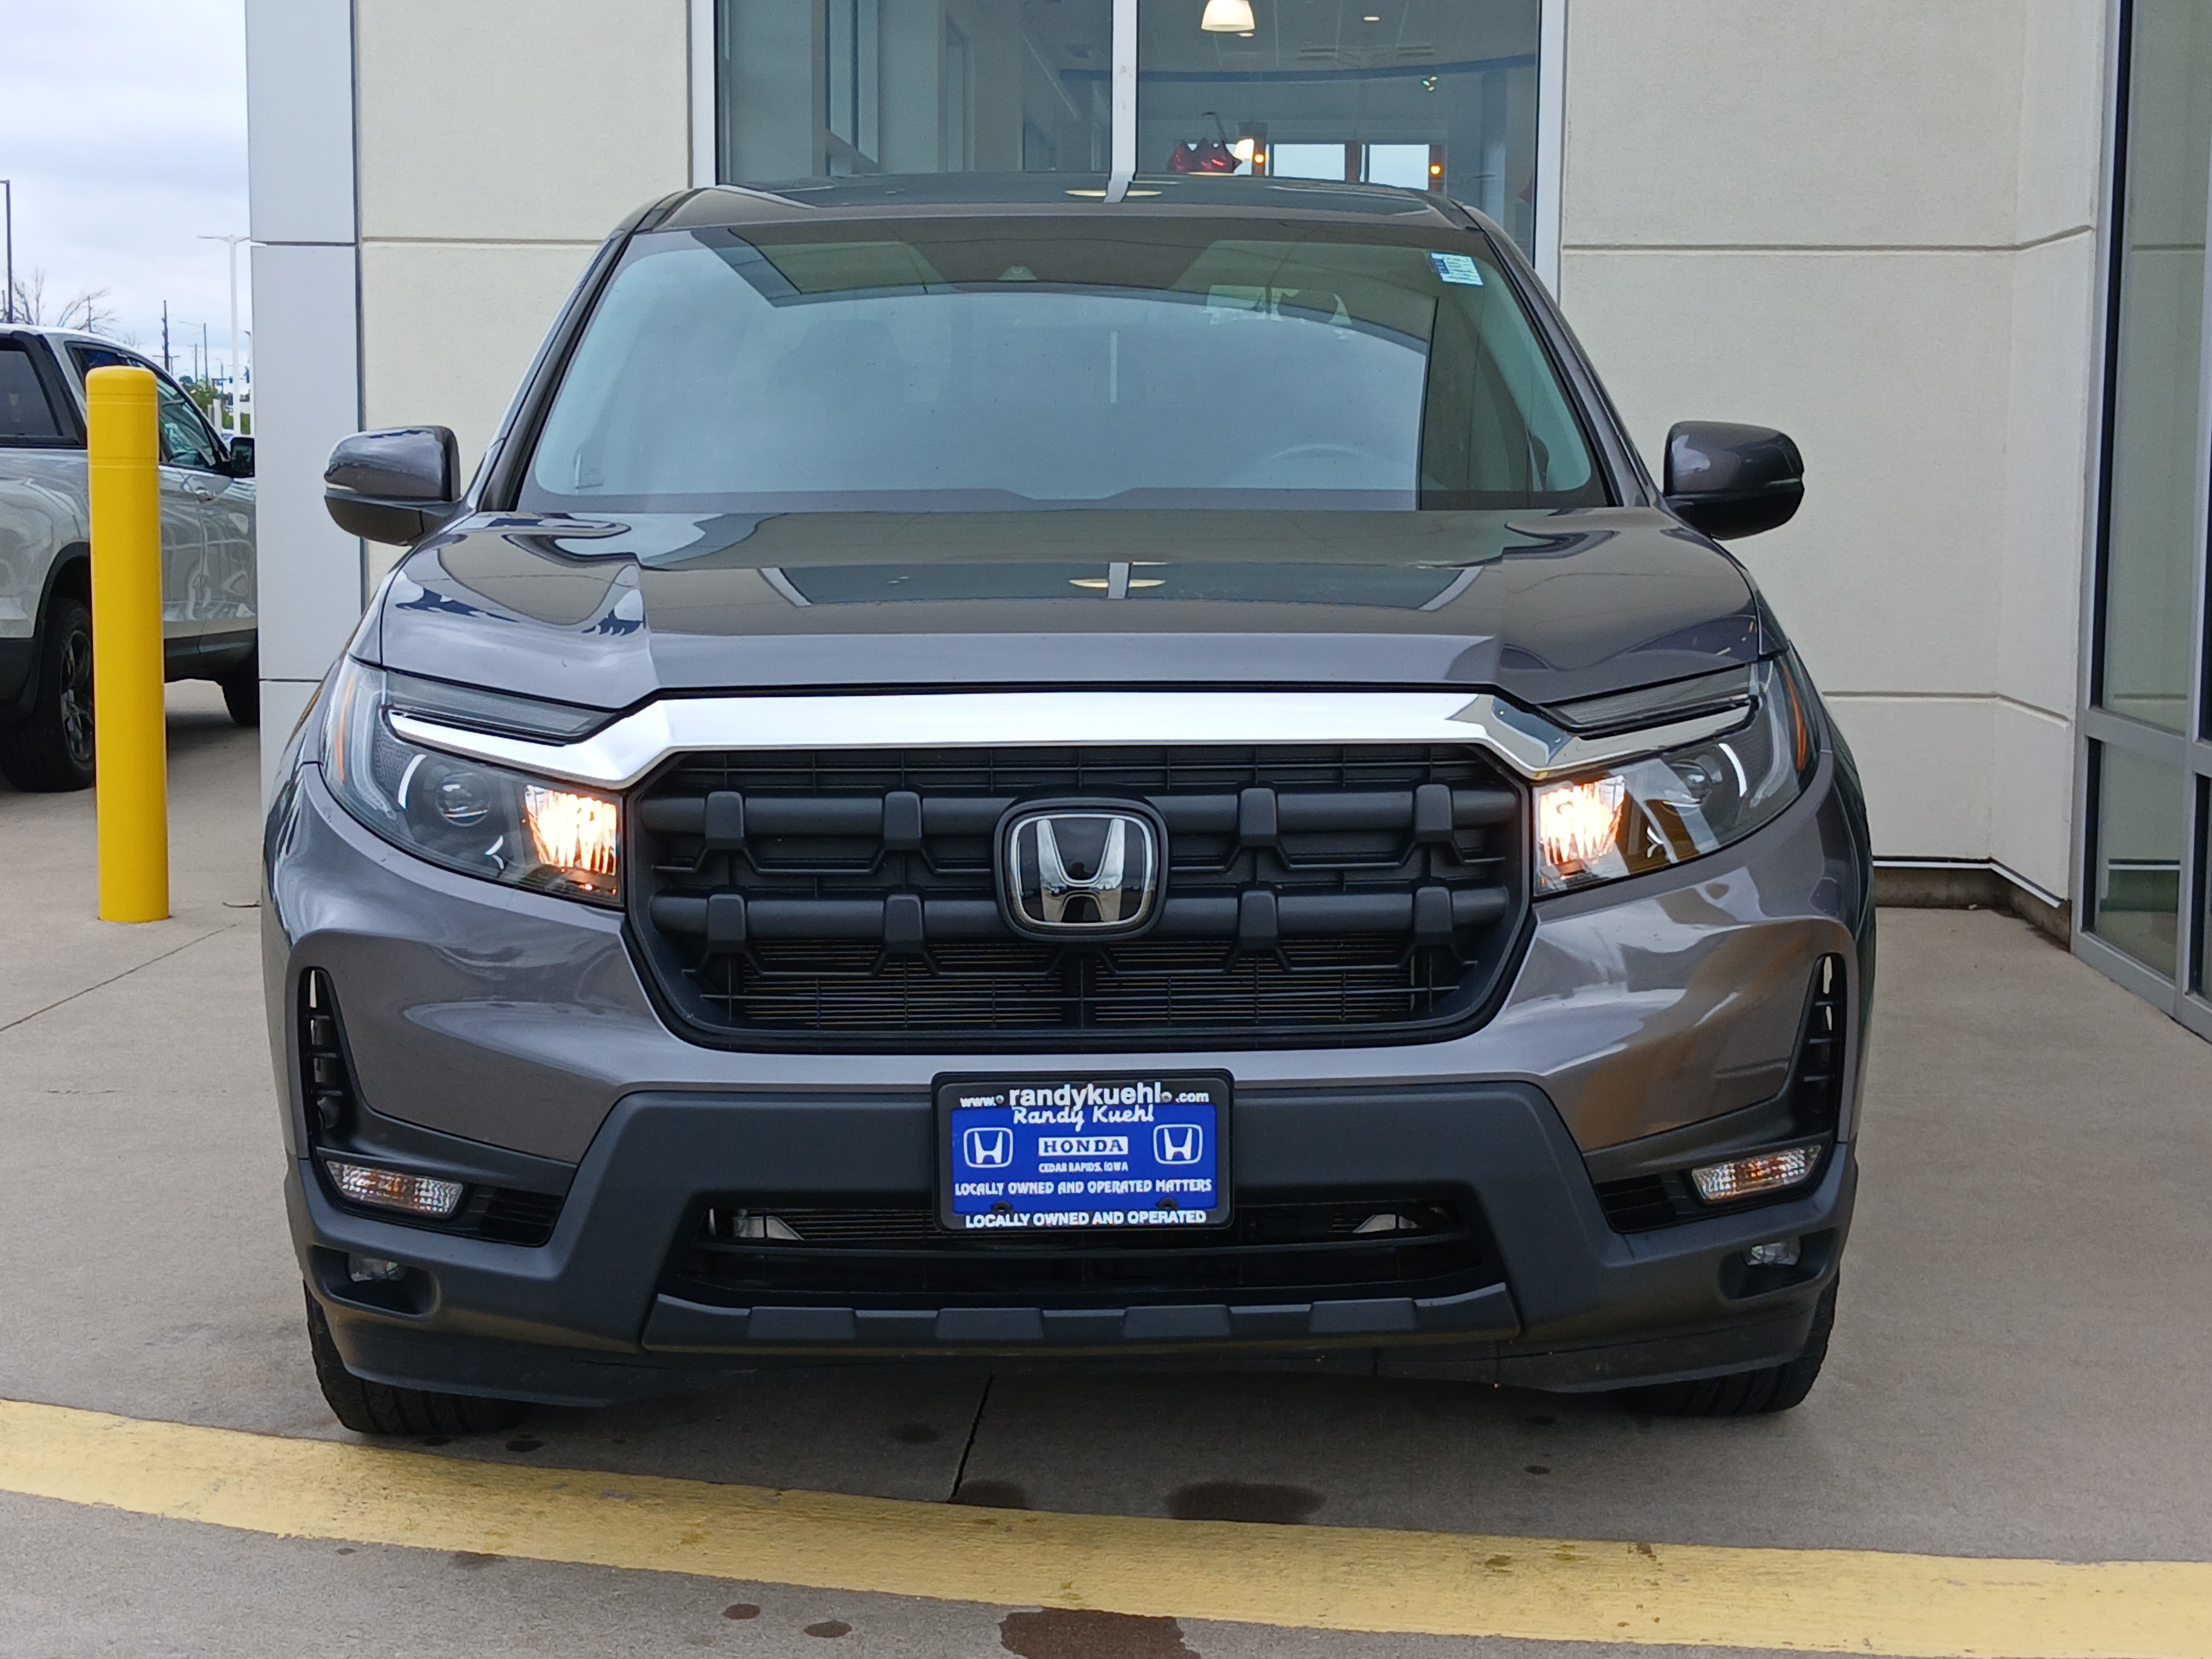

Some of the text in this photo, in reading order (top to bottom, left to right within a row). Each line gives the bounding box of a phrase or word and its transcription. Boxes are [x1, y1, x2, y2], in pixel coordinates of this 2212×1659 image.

[1012, 1104, 1154, 1132] Randy Kuehl
[1044, 1140, 1124, 1153] HONDA
[1039, 1162, 1068, 1173] CEDAR
[1103, 1161, 1129, 1172] IOWA
[955, 1179, 1212, 1196] LOCALLY OWNED AND OPERATED MATTERS
[966, 1210, 1207, 1229] LOCALLY OWNED AND OPERATED
